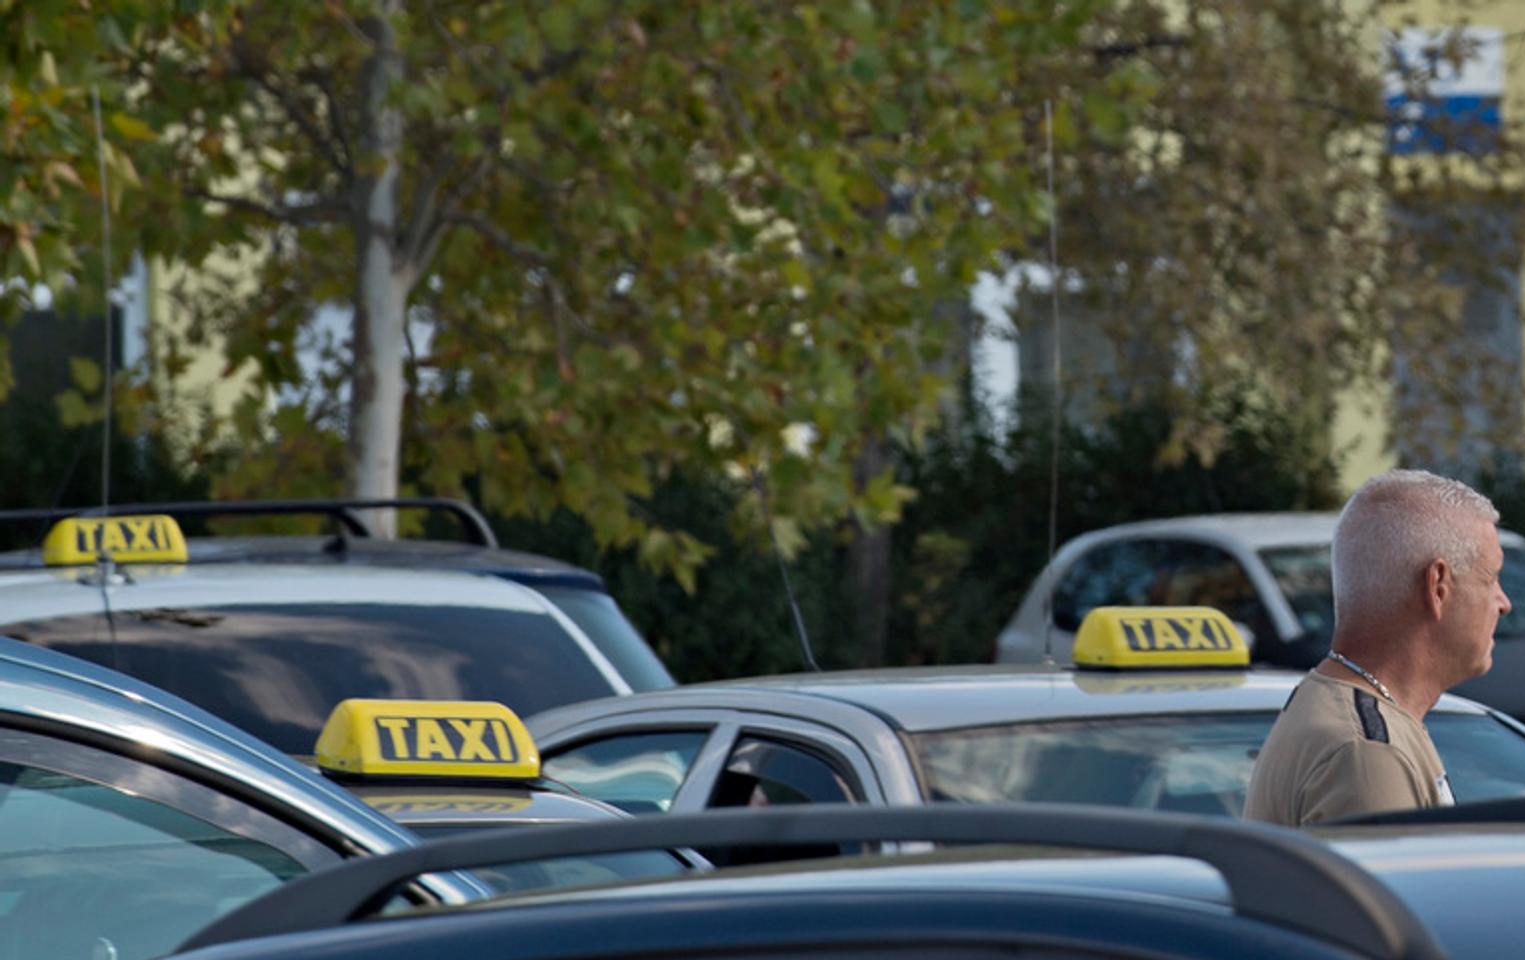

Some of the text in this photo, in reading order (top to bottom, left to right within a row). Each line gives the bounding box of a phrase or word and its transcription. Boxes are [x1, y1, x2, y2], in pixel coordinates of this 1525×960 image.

[78, 522, 170, 551] TAXI
[1122, 618, 1231, 651] TAXI
[377, 718, 515, 761] TAXI
